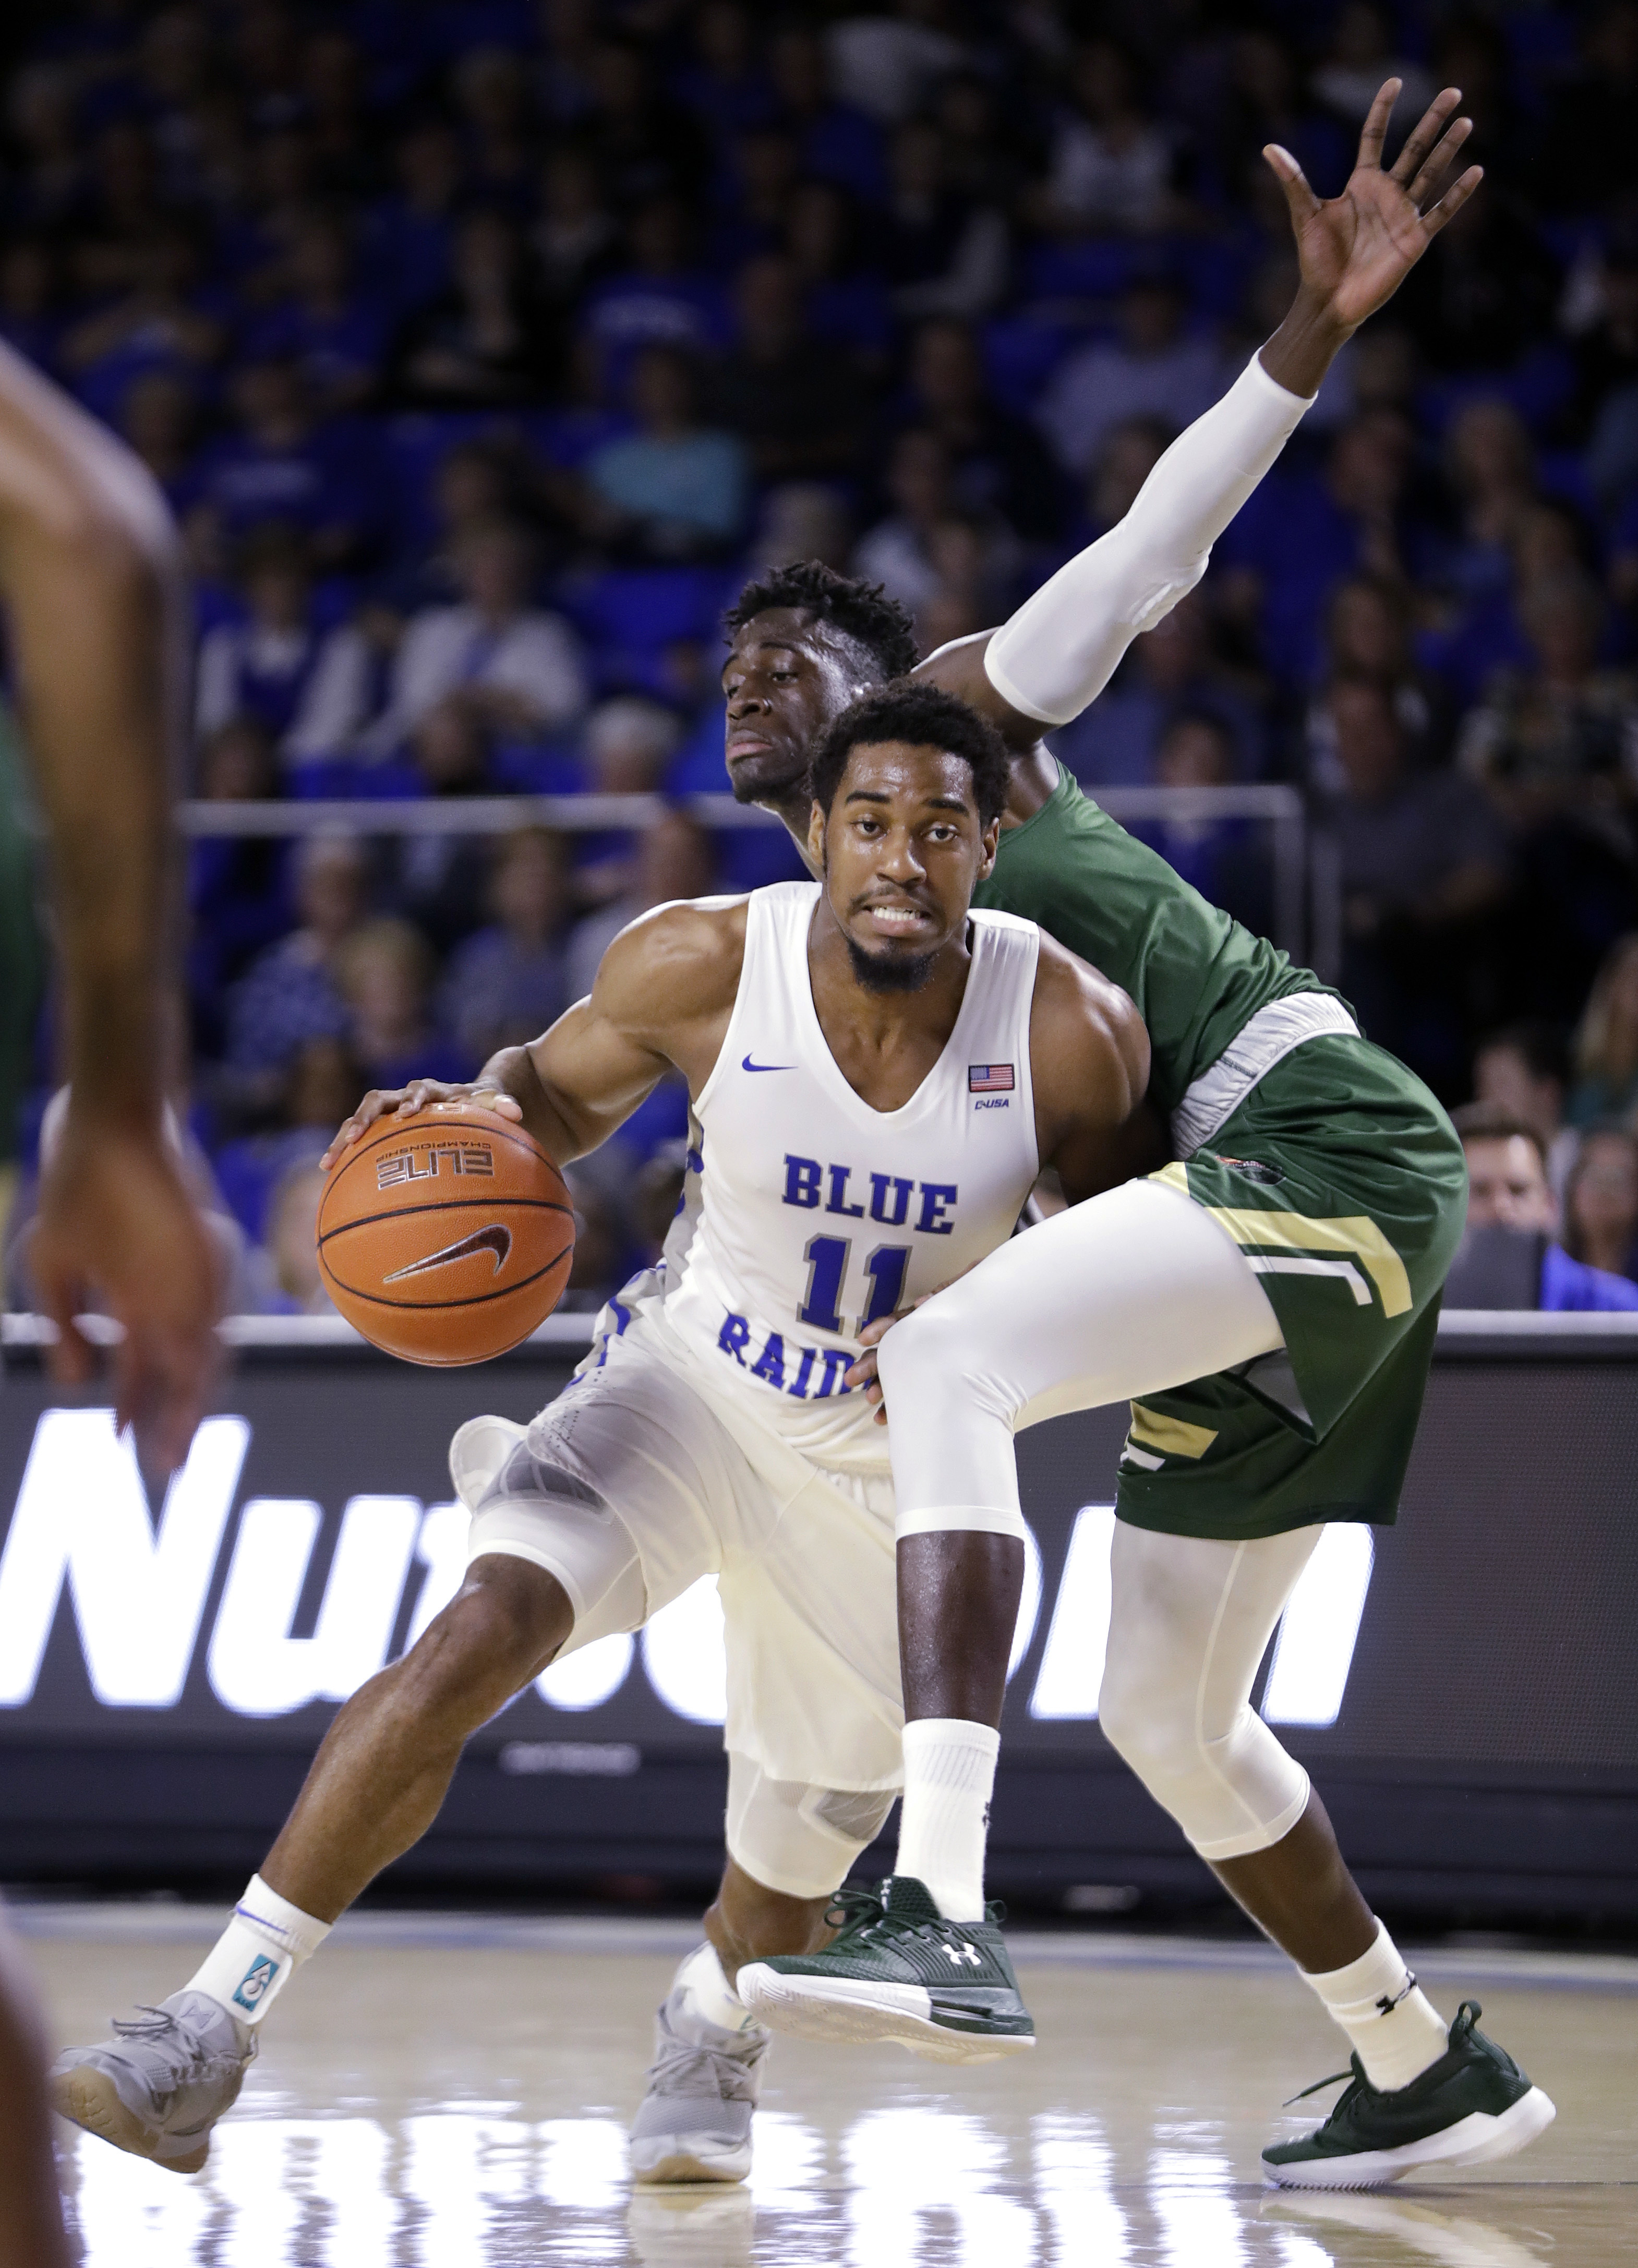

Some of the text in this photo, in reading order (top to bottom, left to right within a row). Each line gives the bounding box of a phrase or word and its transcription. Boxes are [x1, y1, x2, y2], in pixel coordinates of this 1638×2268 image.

[974, 1098, 1009, 1110] C-USA
[376, 1141, 491, 1162] CHAMPIONSHIP
[377, 1149, 494, 1190] ELITE
[781, 1153, 959, 1235] BLUE
[796, 1232, 913, 1339] 11
[717, 1312, 878, 1400] RAID
